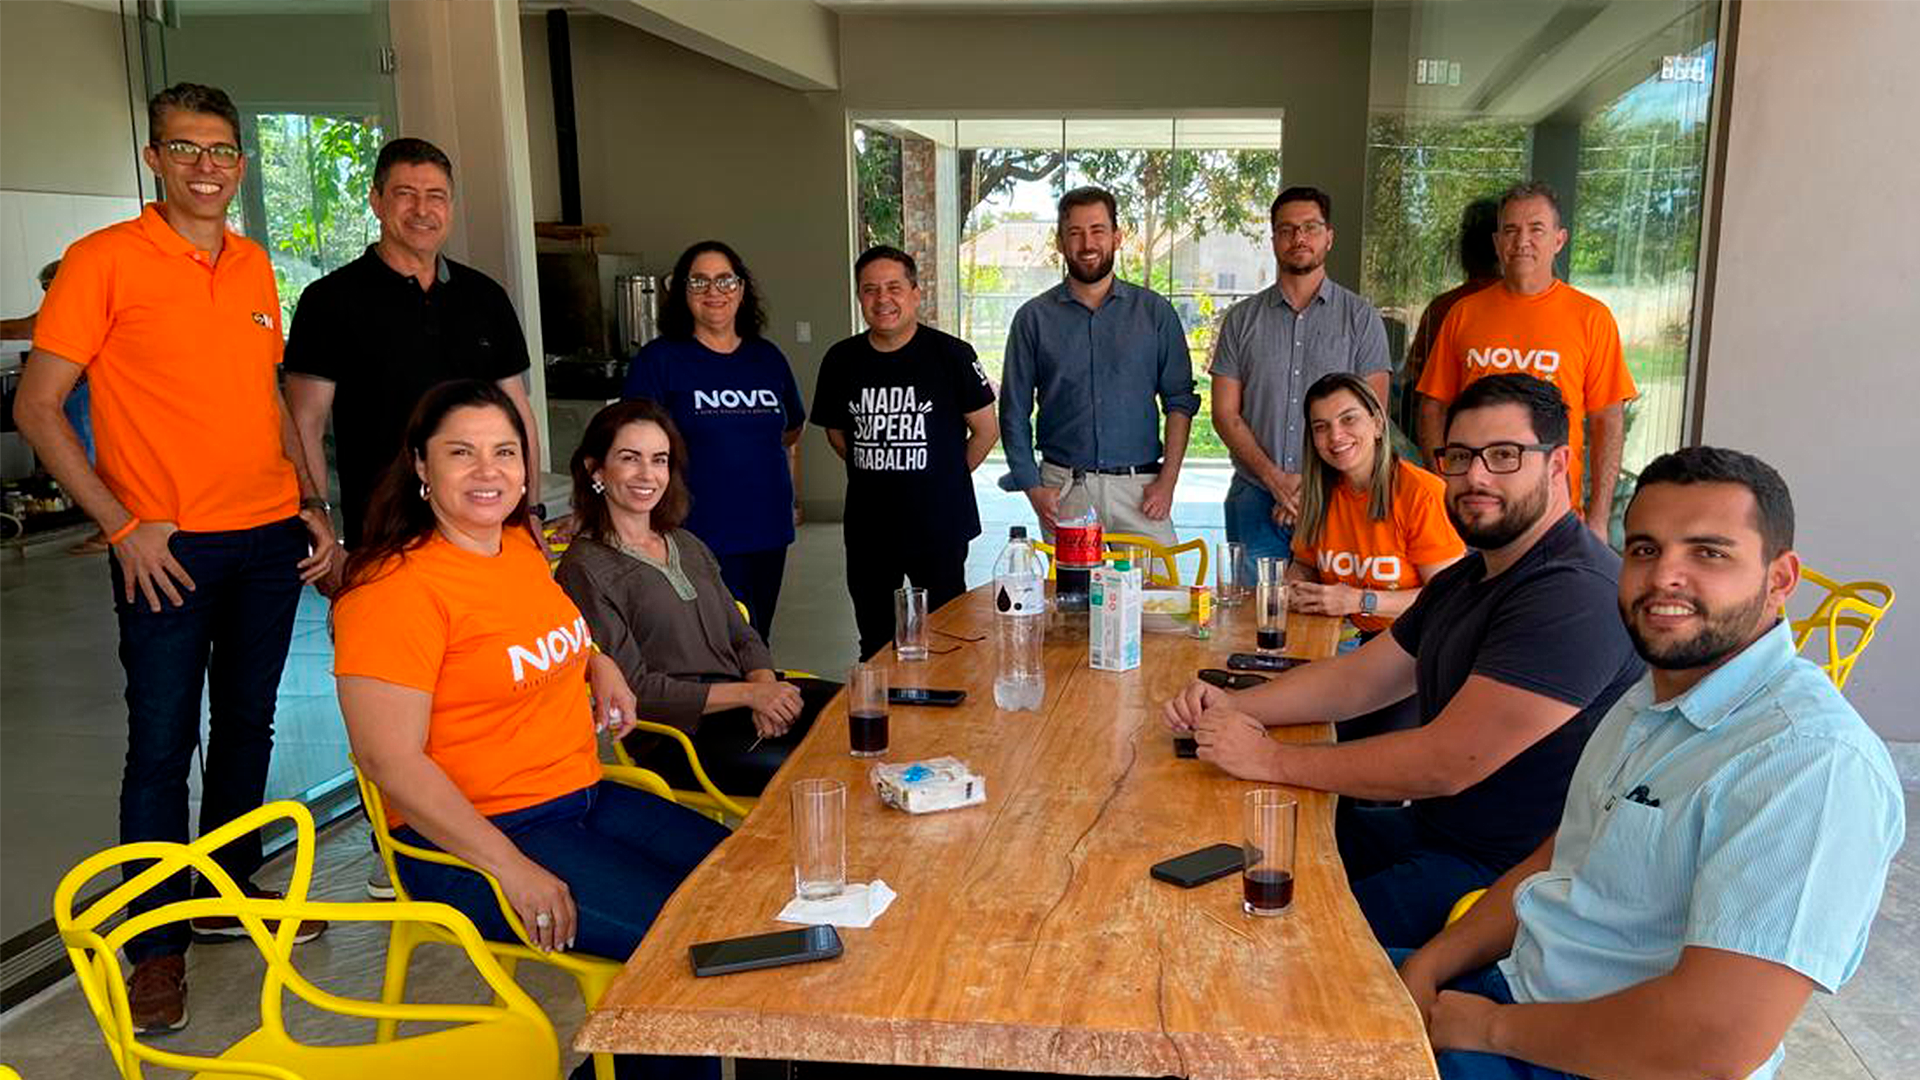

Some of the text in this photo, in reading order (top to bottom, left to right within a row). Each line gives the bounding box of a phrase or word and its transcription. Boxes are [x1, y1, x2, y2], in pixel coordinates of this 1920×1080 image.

[1467, 347, 1560, 372] NOVO
[694, 389, 779, 409] NOVO
[861, 386, 916, 414] NADA
[854, 413, 926, 440] SUPERA
[1317, 549, 1400, 581] NOVO
